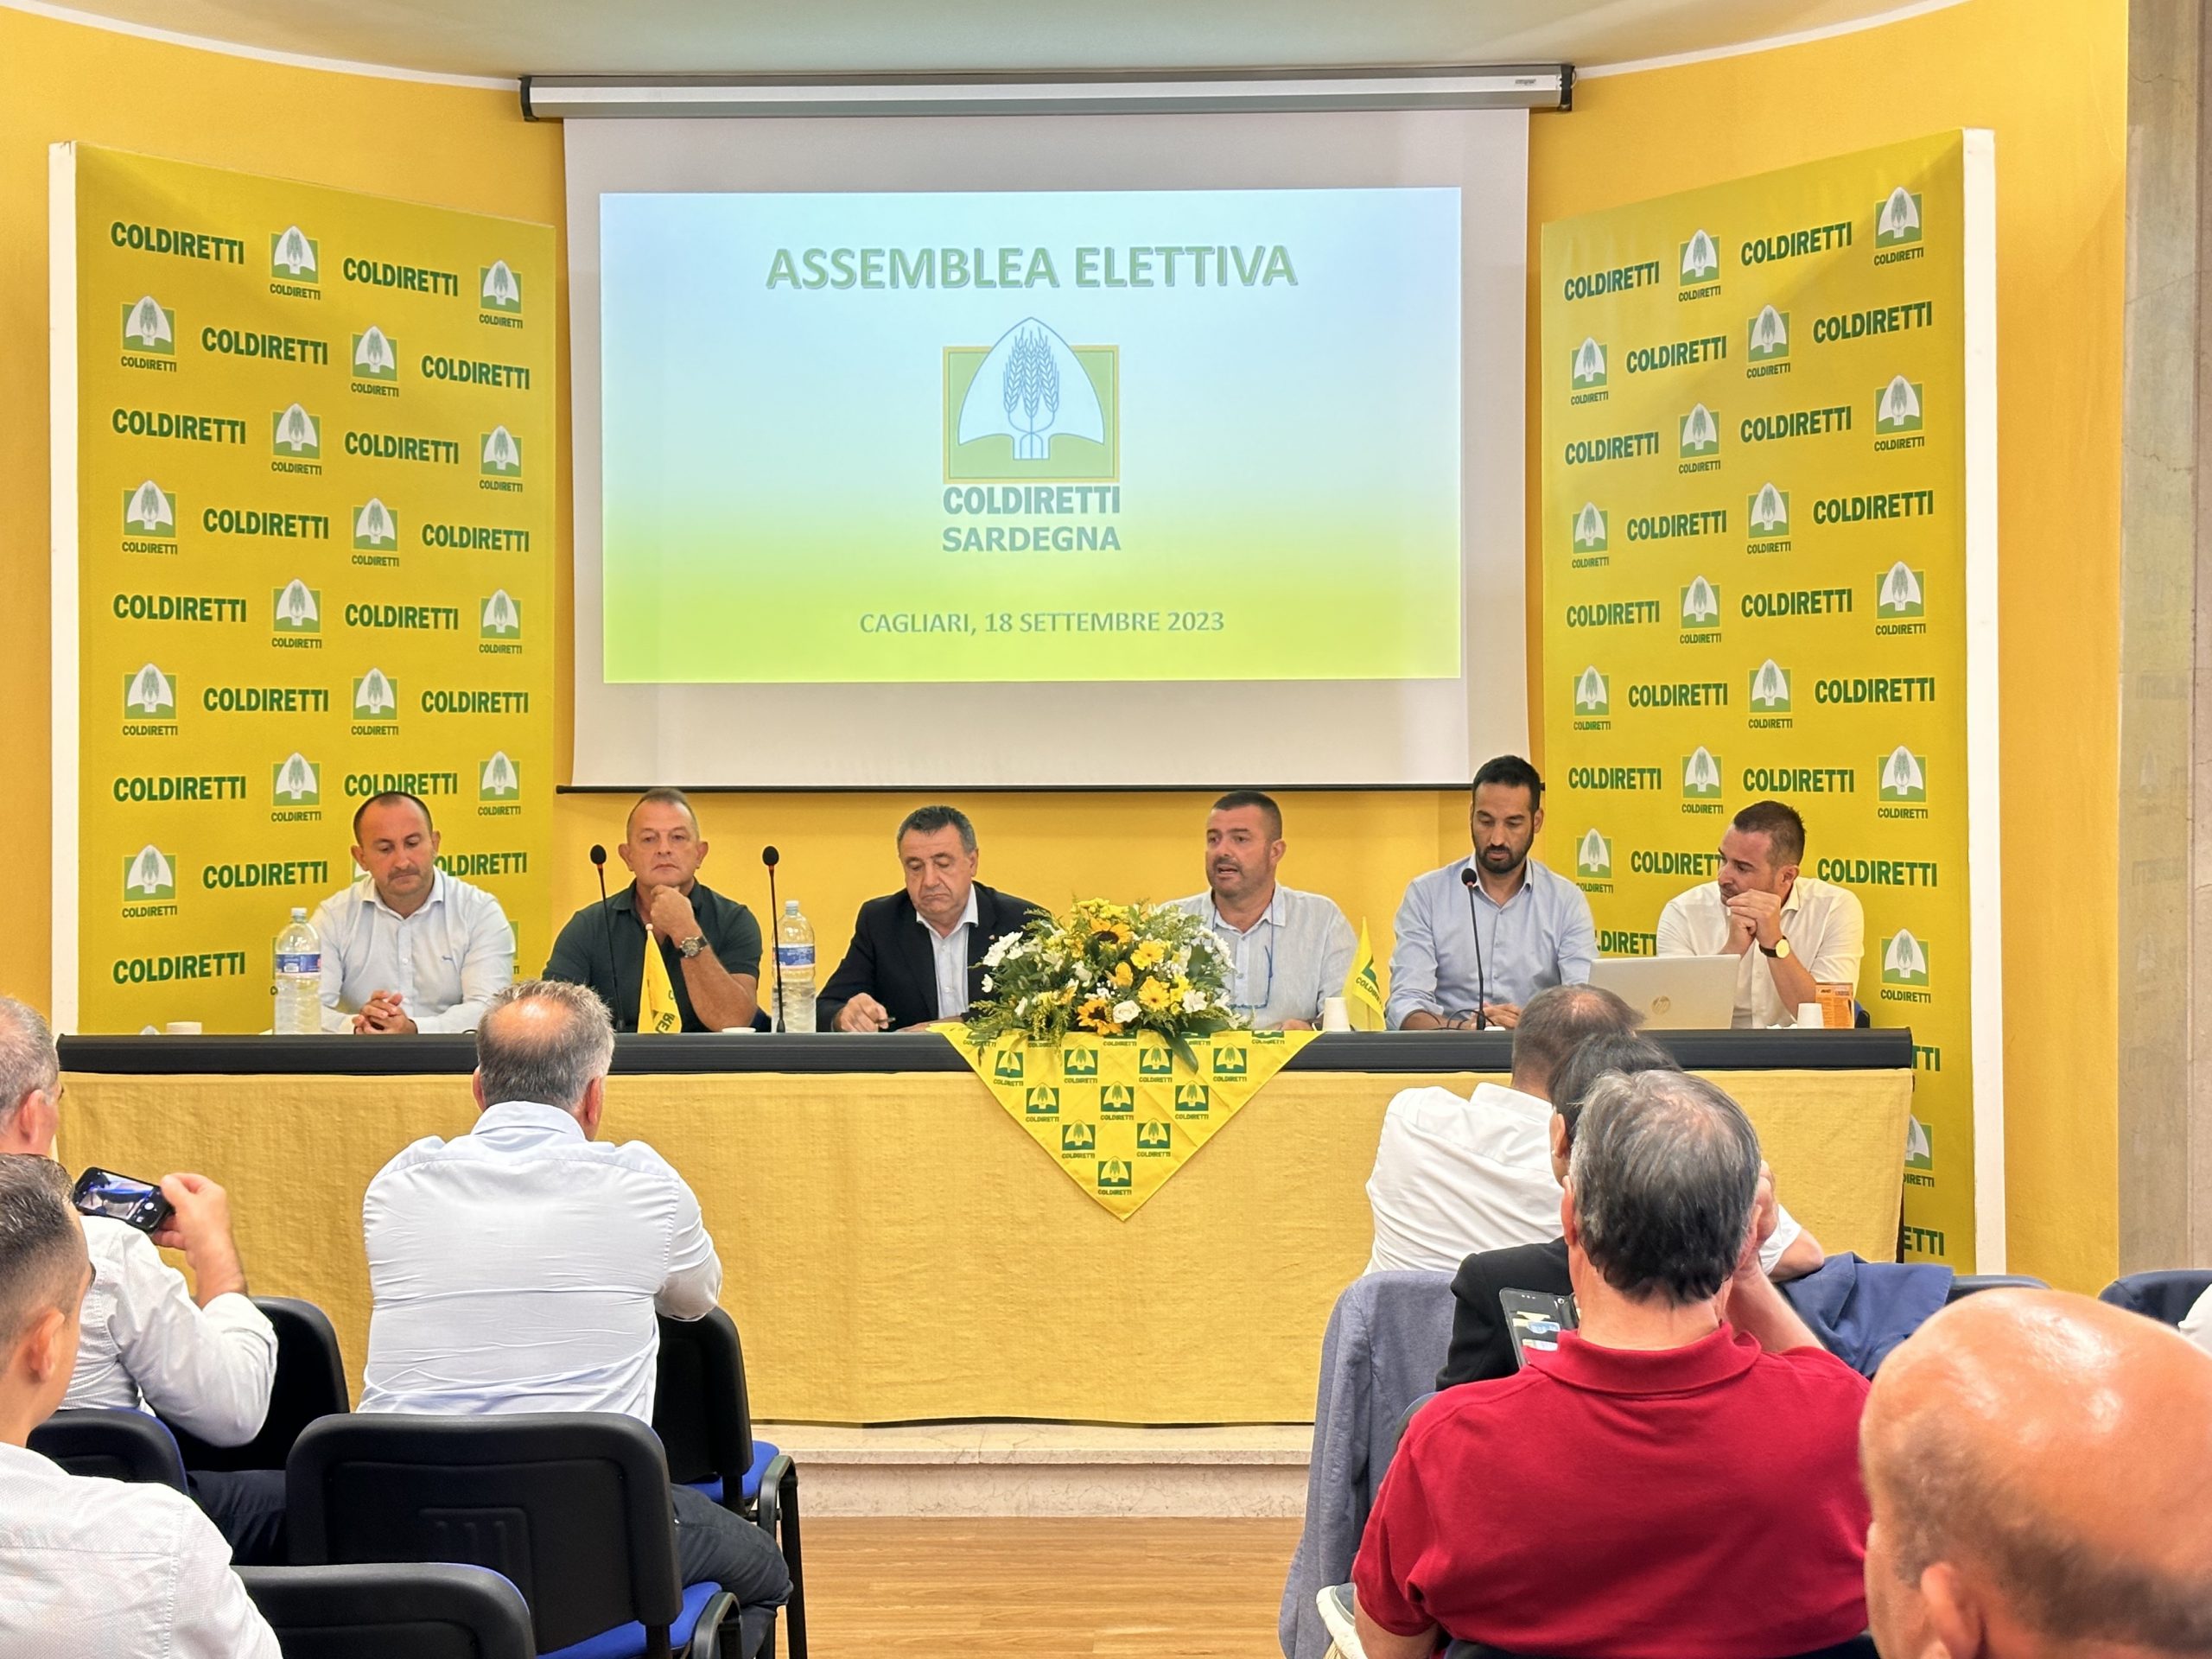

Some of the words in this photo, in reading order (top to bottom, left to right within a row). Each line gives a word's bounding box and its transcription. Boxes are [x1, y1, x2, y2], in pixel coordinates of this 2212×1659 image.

[111, 221, 245, 265] COLDIRETTI
[1741, 221, 1853, 266] COLDIRETTI
[766, 246, 1058, 289] ASSEMBLEA
[1075, 245, 1297, 287] ELETTIVA
[1873, 246, 1924, 266] COLDIRETTI
[343, 257, 458, 297] COLDIRETTI
[1564, 261, 1660, 302] COLDIRETTI
[270, 283, 321, 301] COLDIRETTI
[1678, 285, 1721, 302] COLDIRETTI
[479, 314, 524, 329] COLDIRETTI
[1813, 301, 1932, 344] COLDIRETTI
[201, 327, 328, 365] COLDIRETTI
[1626, 335, 1727, 374] COLDIRETTI
[120, 356, 177, 372] COLDIRETTI
[421, 355, 530, 391] COLDIRETTI
[1746, 362, 1791, 379] COLDIRETTI
[351, 382, 399, 397] COLDIRETTI
[1570, 391, 1609, 406] COLDIRETTI
[112, 409, 246, 444] COLDIRETTI
[1740, 405, 1852, 443] COLDIRETTI
[344, 431, 459, 465] COLDIRETTI
[1565, 431, 1659, 466] COLDIRETTI
[1873, 435, 1925, 452] COLDIRETTI
[270, 461, 322, 475] COLDIRETTI
[1678, 460, 1721, 474] COLDIRETTI
[479, 480, 524, 493] COLDIRETTI
[942, 486, 1121, 515] COLDIRETTI
[1813, 490, 1934, 524] COLDIRETTI
[203, 508, 329, 540] COLDIRETTI
[1627, 510, 1727, 542] COLDIRETTI
[121, 541, 178, 555] COLDIRETTI
[422, 524, 530, 552] COLDIRETTI
[941, 527, 1121, 552] SARDEGNA
[1746, 541, 1791, 555] COLDIRETTI
[351, 555, 400, 568] COLDIRETTI
[1571, 556, 1610, 569] COLDIRETTI
[113, 594, 247, 623] COLDIRETTI
[1567, 600, 1660, 628] COLDIRETTI
[1741, 588, 1853, 618] COLDIRETTI
[345, 603, 459, 630] COLDIRETTI
[859, 613, 978, 637] CAGLIARI,
[984, 611, 1013, 632] 18
[1018, 611, 1160, 633] SETTEMBRE
[1166, 611, 1224, 632] 2023
[1679, 632, 1722, 645] COLDIRETTI
[1875, 623, 1927, 636] COLDIRETTI
[271, 637, 322, 649] COLDIRETTI
[479, 644, 523, 654] COLDIRETTI
[203, 688, 329, 712] COLDIRETTI
[421, 690, 529, 714] COLDIRETTI
[1628, 683, 1728, 708] COLDIRETTI
[1815, 677, 1936, 704] COLDIRETTI
[122, 725, 178, 736] COLDIRETTI
[351, 725, 399, 736] COLDIRETTI
[1573, 721, 1611, 731] COLDIRETTI
[1748, 718, 1793, 729] COLDIRETTI
[113, 776, 246, 803] COLDIRETTI
[1568, 767, 1662, 790] COLDIRETTI
[1743, 768, 1854, 793] COLDIRETTI
[270, 810, 321, 823] COLDIRETTI
[477, 805, 521, 817] COLDIRETTI
[1681, 804, 1724, 814] COLDIRETTI
[1877, 807, 1929, 819] COLDIRETTI
[202, 861, 327, 889] COLDIRETTI
[435, 853, 527, 878] OLDIRETTI
[1631, 851, 1721, 876] COLDIRET
[1817, 858, 1937, 887] COLDIRETTI
[122, 905, 178, 918] COLDIRETTI
[112, 951, 245, 984] COLDIRETTI
[1880, 988, 1931, 1003] COLDIRETTI
